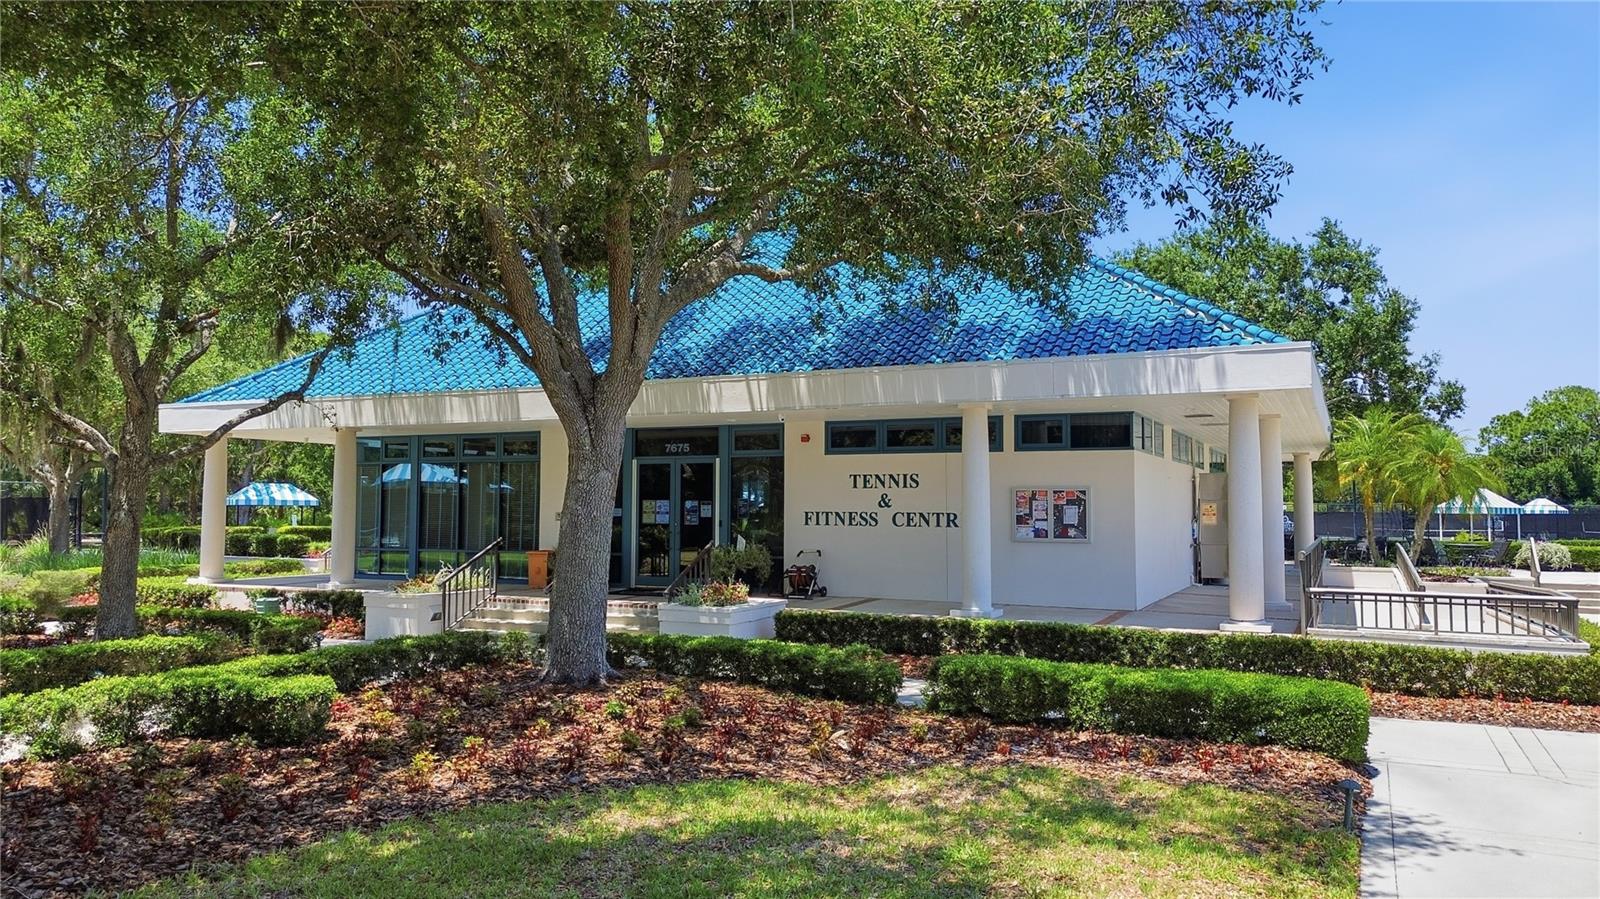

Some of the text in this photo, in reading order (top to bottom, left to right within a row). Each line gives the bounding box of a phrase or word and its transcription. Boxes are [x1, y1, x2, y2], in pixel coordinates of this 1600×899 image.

[664, 442, 690, 453] 7675
[849, 473, 919, 489] TENNIS
[878, 493, 892, 508] &
[804, 511, 960, 528] FITNESS CENTR
